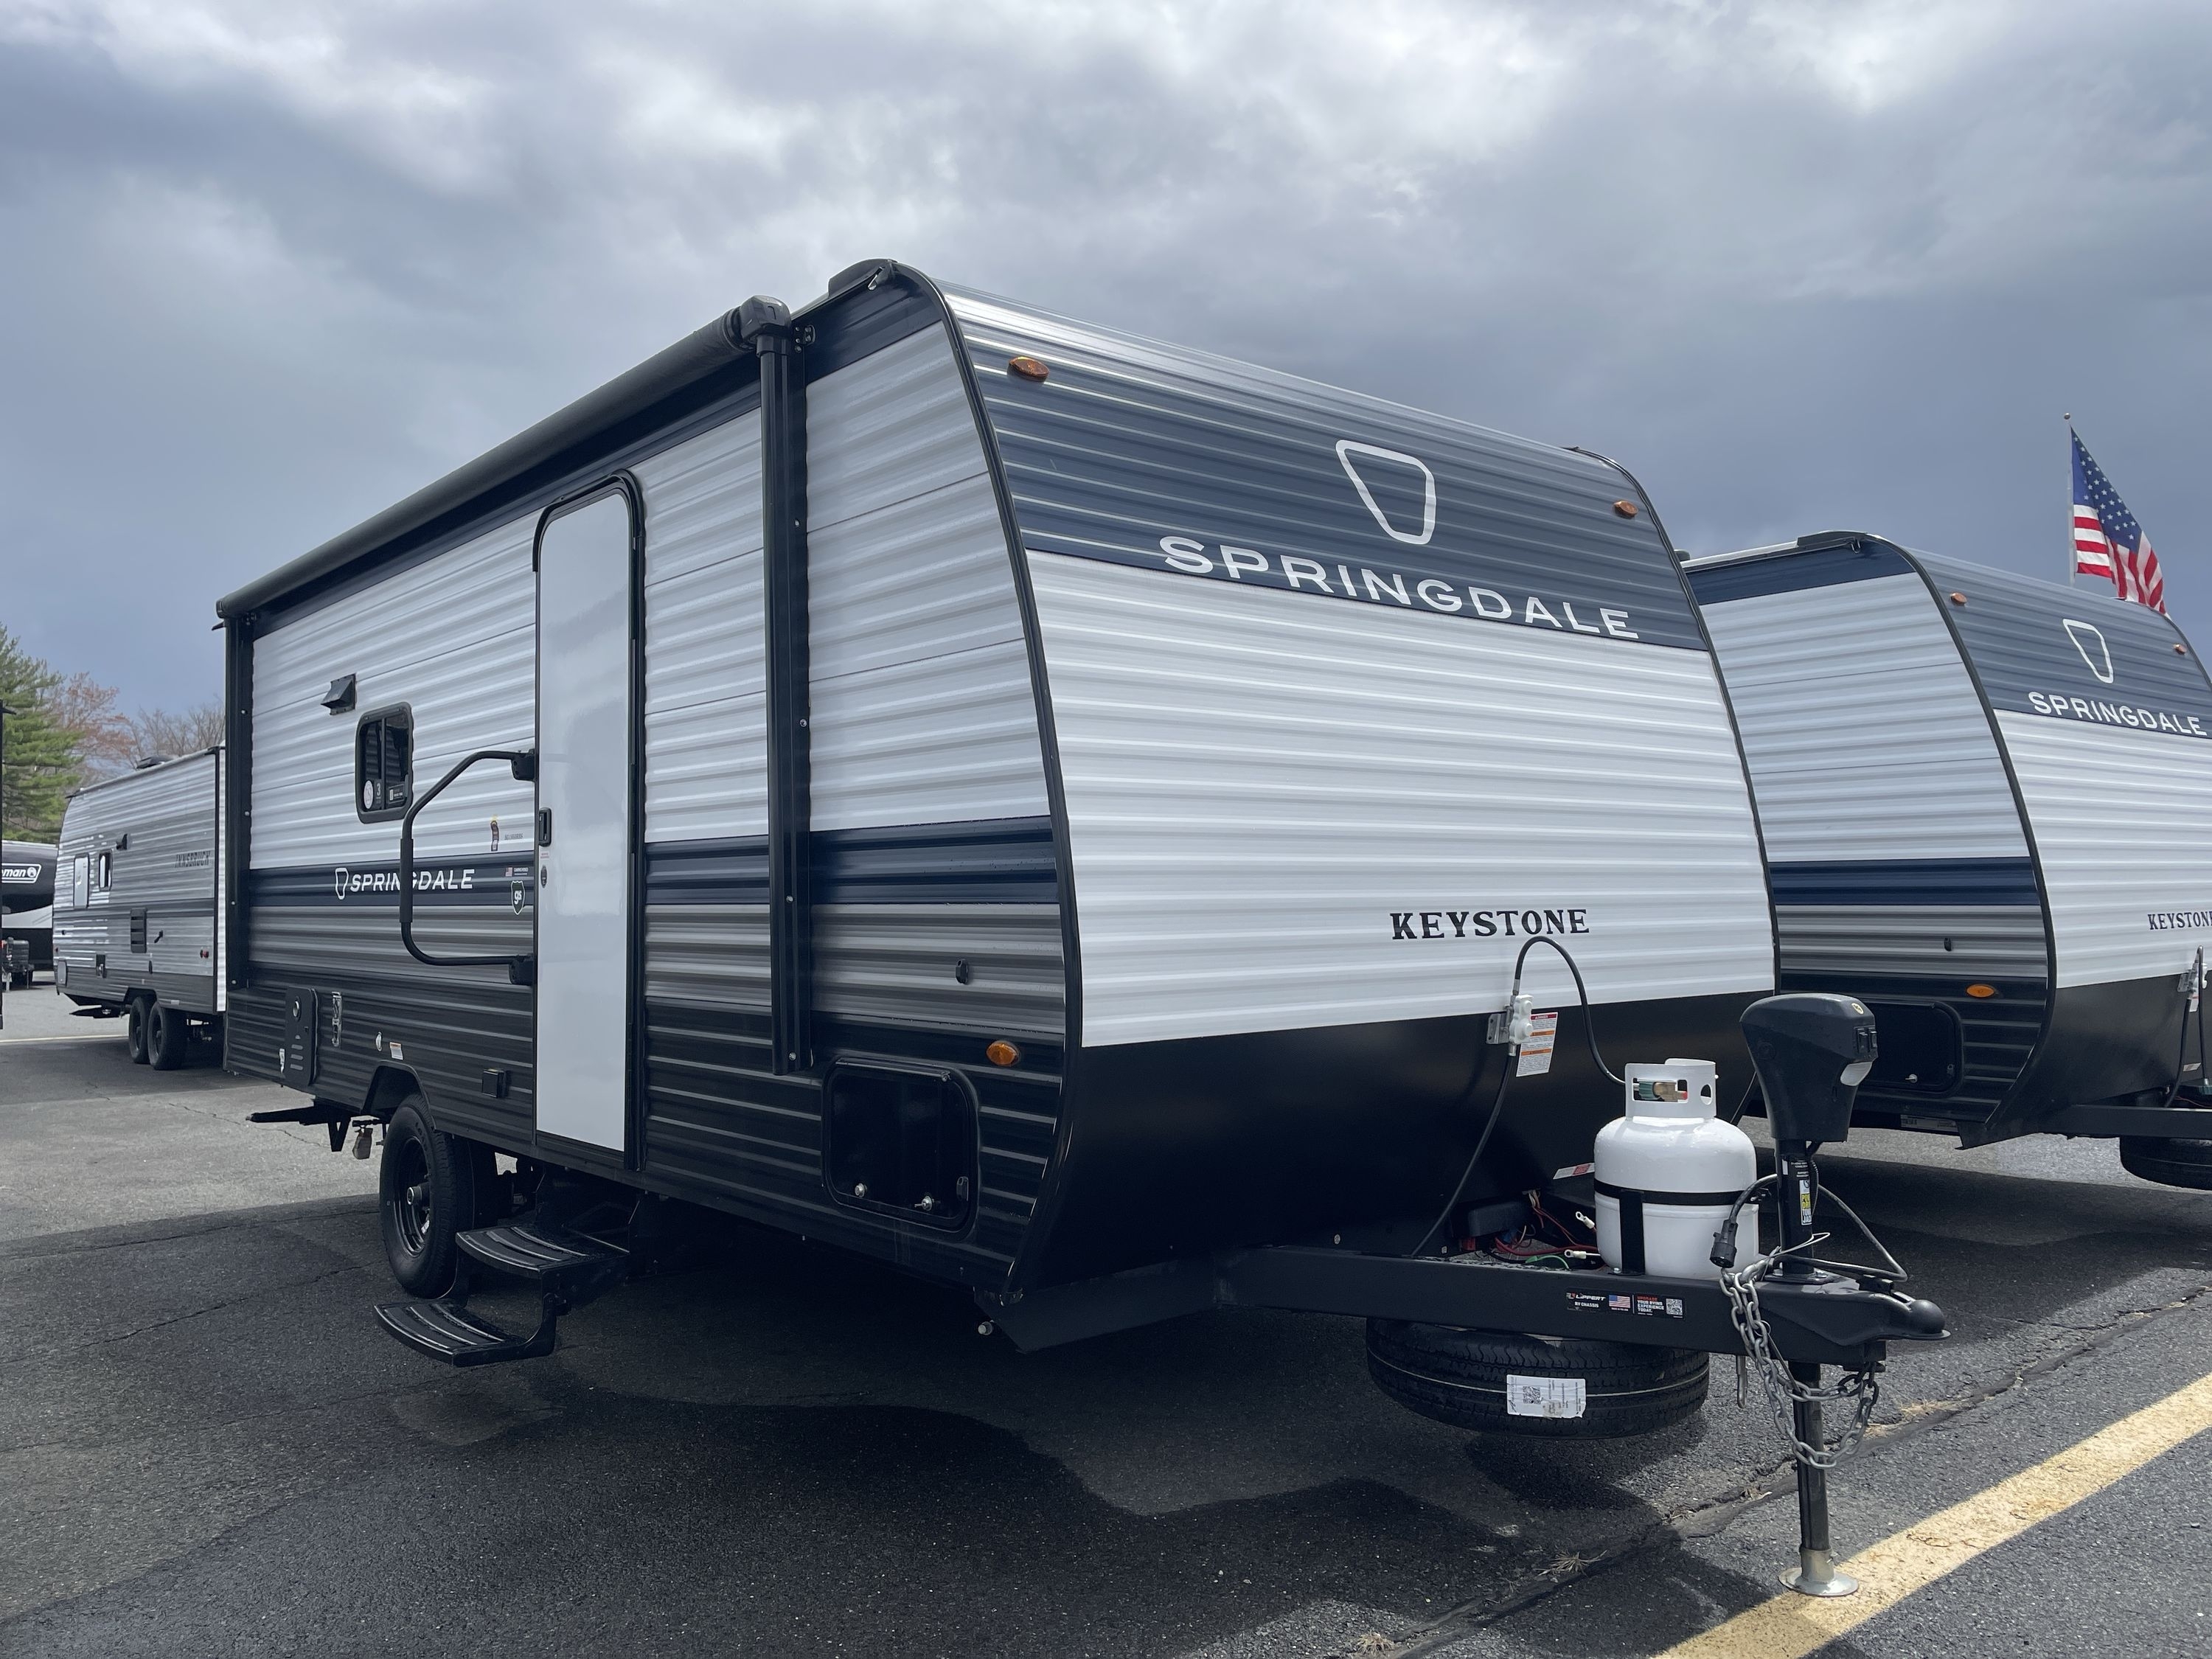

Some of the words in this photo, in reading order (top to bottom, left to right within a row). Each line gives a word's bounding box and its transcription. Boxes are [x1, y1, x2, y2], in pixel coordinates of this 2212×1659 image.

[1159, 536, 1639, 639] SPRINGDALE
[2028, 692, 2208, 736] SPRINGDALE
[2, 869, 26, 877] man
[1390, 909, 1590, 940] KEYSTONE
